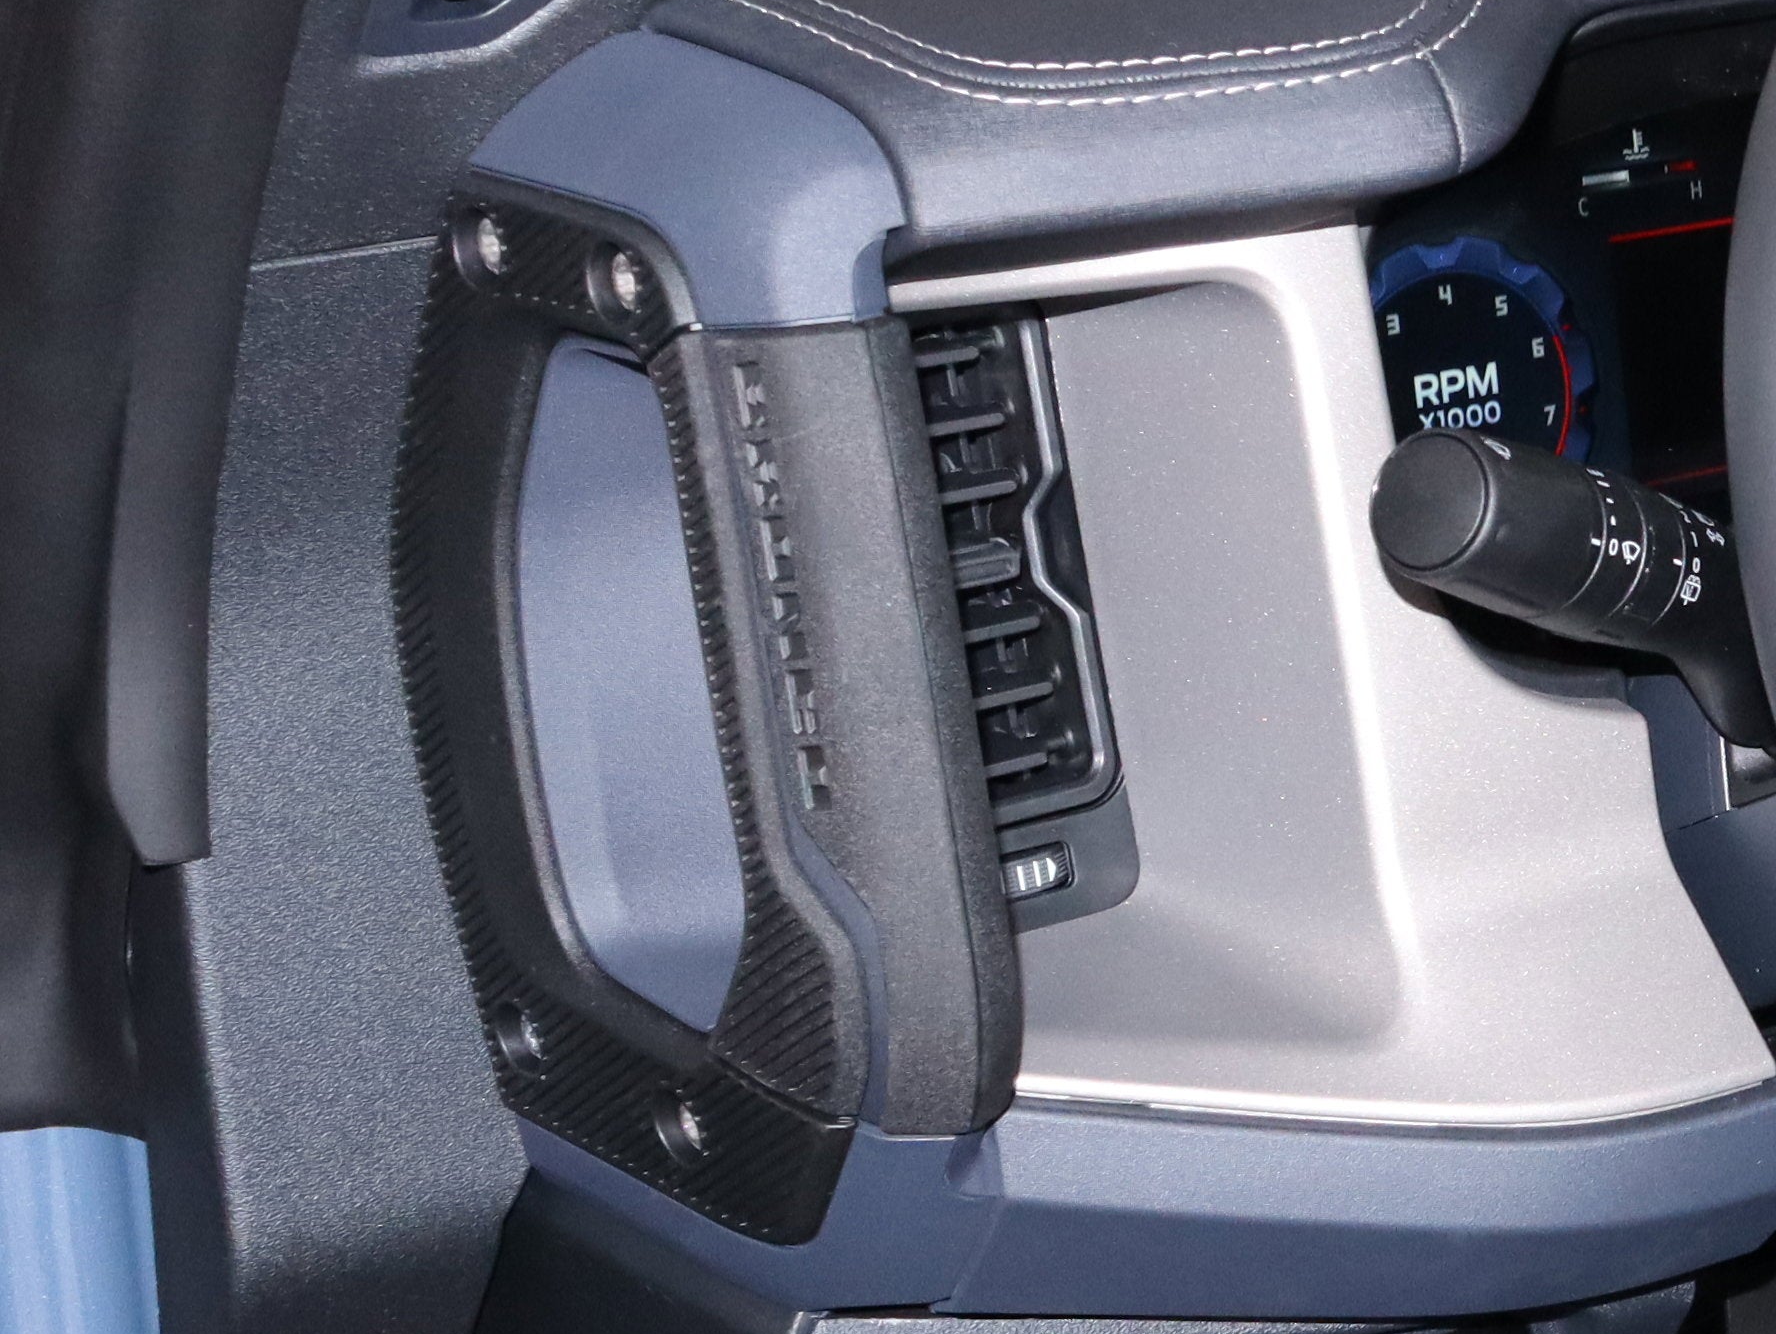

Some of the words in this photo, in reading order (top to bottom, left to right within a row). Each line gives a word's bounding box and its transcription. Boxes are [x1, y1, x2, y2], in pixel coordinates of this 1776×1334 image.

[1578, 197, 1590, 217] C
[1690, 179, 1703, 200] H
[1438, 284, 1453, 306] 4
[1494, 295, 1508, 317] 5
[1386, 313, 1401, 336] 3
[1531, 337, 1545, 359] 6
[1413, 361, 1499, 409] RPM
[1419, 400, 1502, 431] X1000
[1544, 404, 1556, 427] 7
